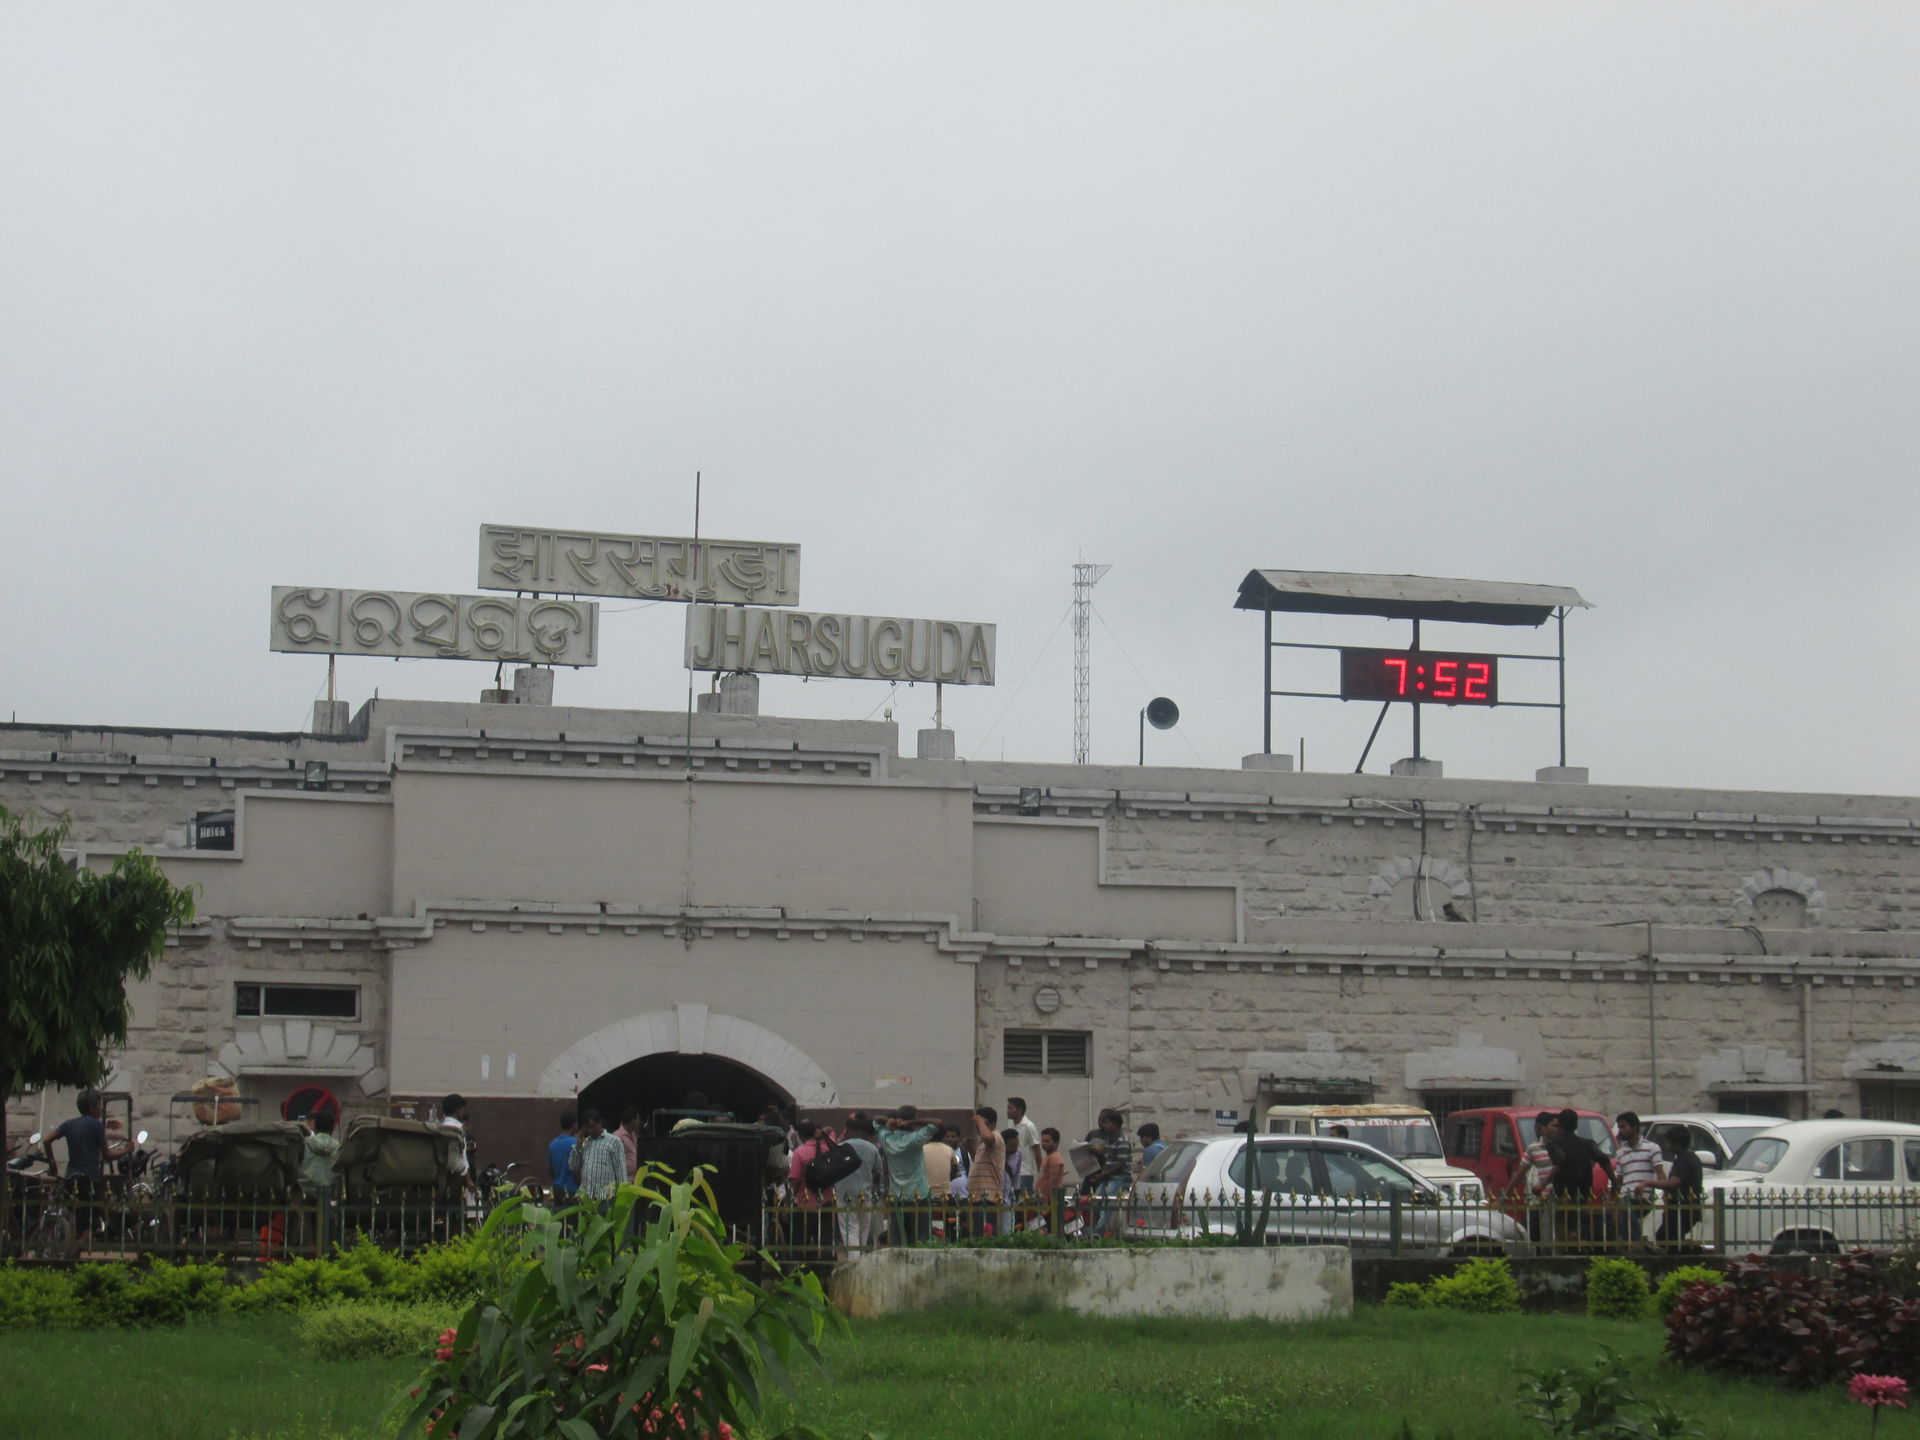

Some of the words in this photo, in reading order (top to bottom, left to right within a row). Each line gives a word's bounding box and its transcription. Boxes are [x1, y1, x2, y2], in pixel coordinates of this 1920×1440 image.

[487, 529, 798, 601] झारसुगुड़ा
[693, 607, 993, 684] JHARSUGUDA
[1384, 658, 1490, 699] 7:52
